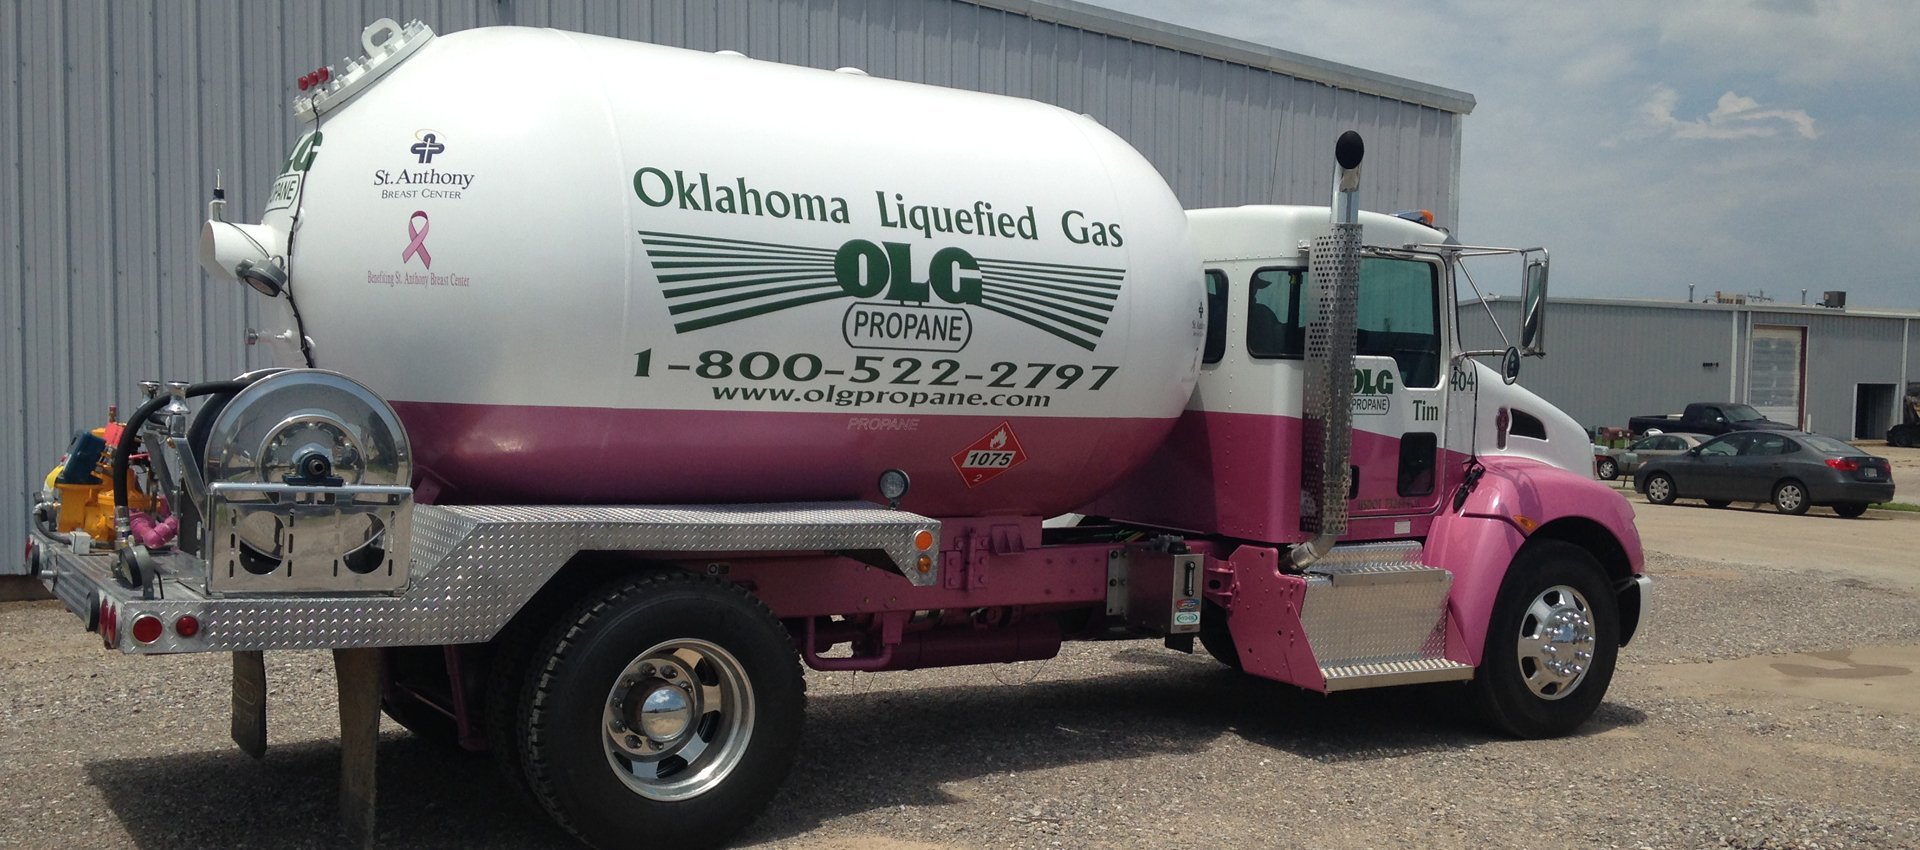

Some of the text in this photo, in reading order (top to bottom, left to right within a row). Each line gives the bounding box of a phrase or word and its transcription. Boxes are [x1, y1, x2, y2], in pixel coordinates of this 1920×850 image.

[280, 131, 323, 175] LG
[373, 168, 475, 190] St. Anthony
[633, 166, 1124, 248] Oklahoma Liquefied Gas
[367, 270, 394, 287] Benefiting
[405, 272, 429, 288] Anthony
[430, 272, 449, 286] Breast
[450, 273, 470, 287] Center
[834, 238, 983, 304] OLG
[854, 311, 963, 342] PROPANE
[634, 348, 1119, 391] 1-800-522-2797
[1451, 372, 1474, 392] 404
[712, 384, 1051, 408] www.olgpropane.com
[1352, 399, 1387, 411] PROPANE
[1413, 400, 1439, 421] Tim
[847, 417, 921, 432] PROPANE
[970, 452, 1012, 466] 1075
[973, 474, 983, 482] 2
